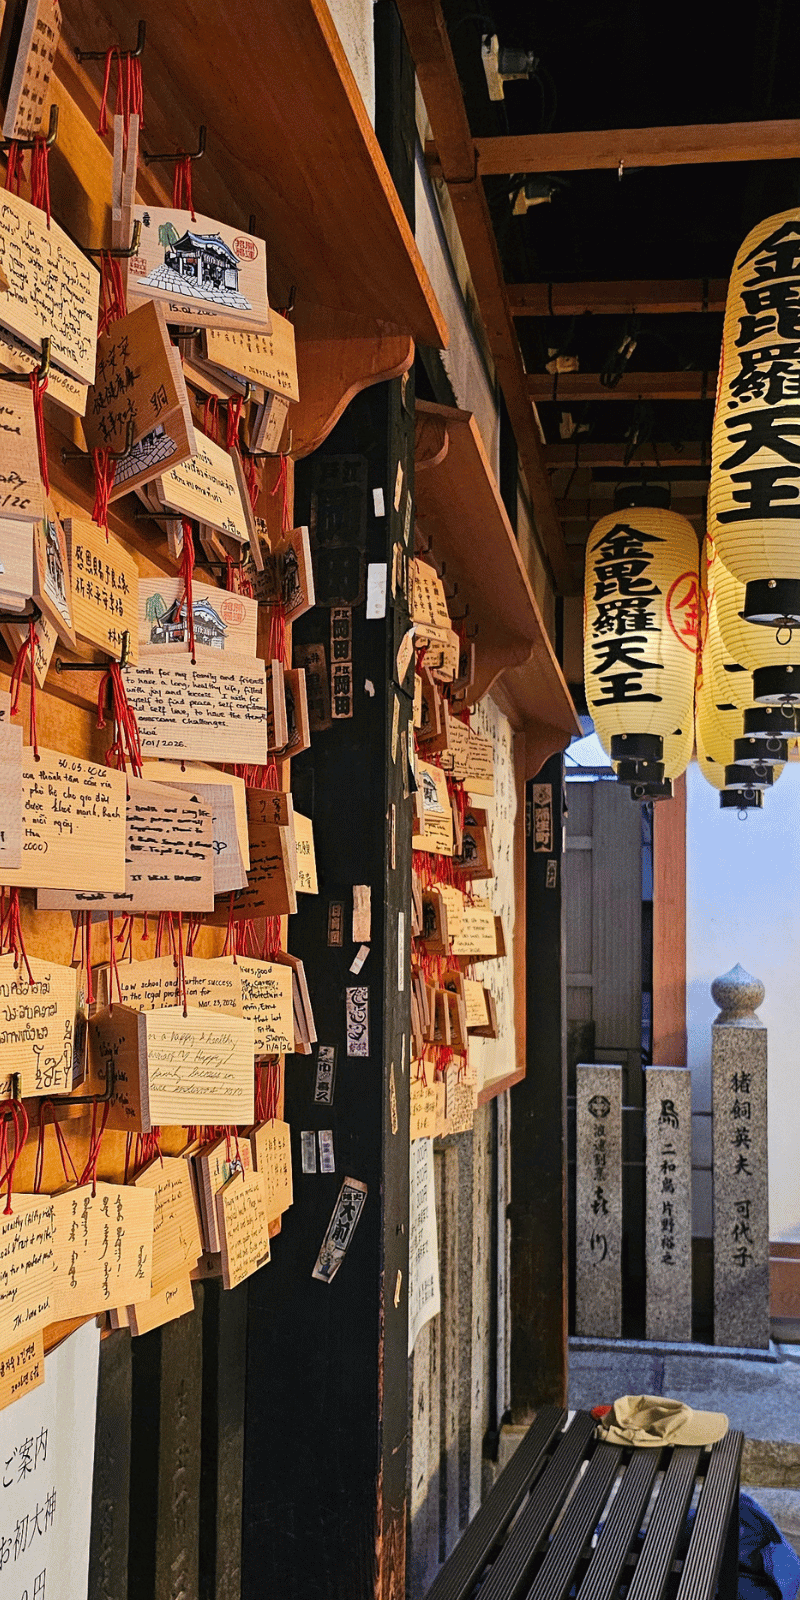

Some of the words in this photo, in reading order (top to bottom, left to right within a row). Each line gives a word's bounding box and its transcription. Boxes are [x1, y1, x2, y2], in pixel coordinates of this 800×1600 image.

[716, 220, 800, 524] 金毘羅天王
[590, 523, 667, 706] 金毘羅天王
[124, 666, 131, 674] I
[159, 668, 170, 678] for
[175, 671, 187, 680] my
[192, 671, 217, 683] family
[239, 676, 264, 685] friends
[138, 677, 156, 685] have
[192, 681, 221, 694] healthy
[149, 687, 161, 697] joy
[218, 701, 234, 711] self
[140, 978, 161, 988] school
[207, 978, 233, 987] success
[130, 991, 142, 1000] the
[144, 989, 161, 1002] legal
[200, 988, 211, 996] for
[3, 1426, 48, 1488] ご案内
[0, 1486, 57, 1571] お初大神
